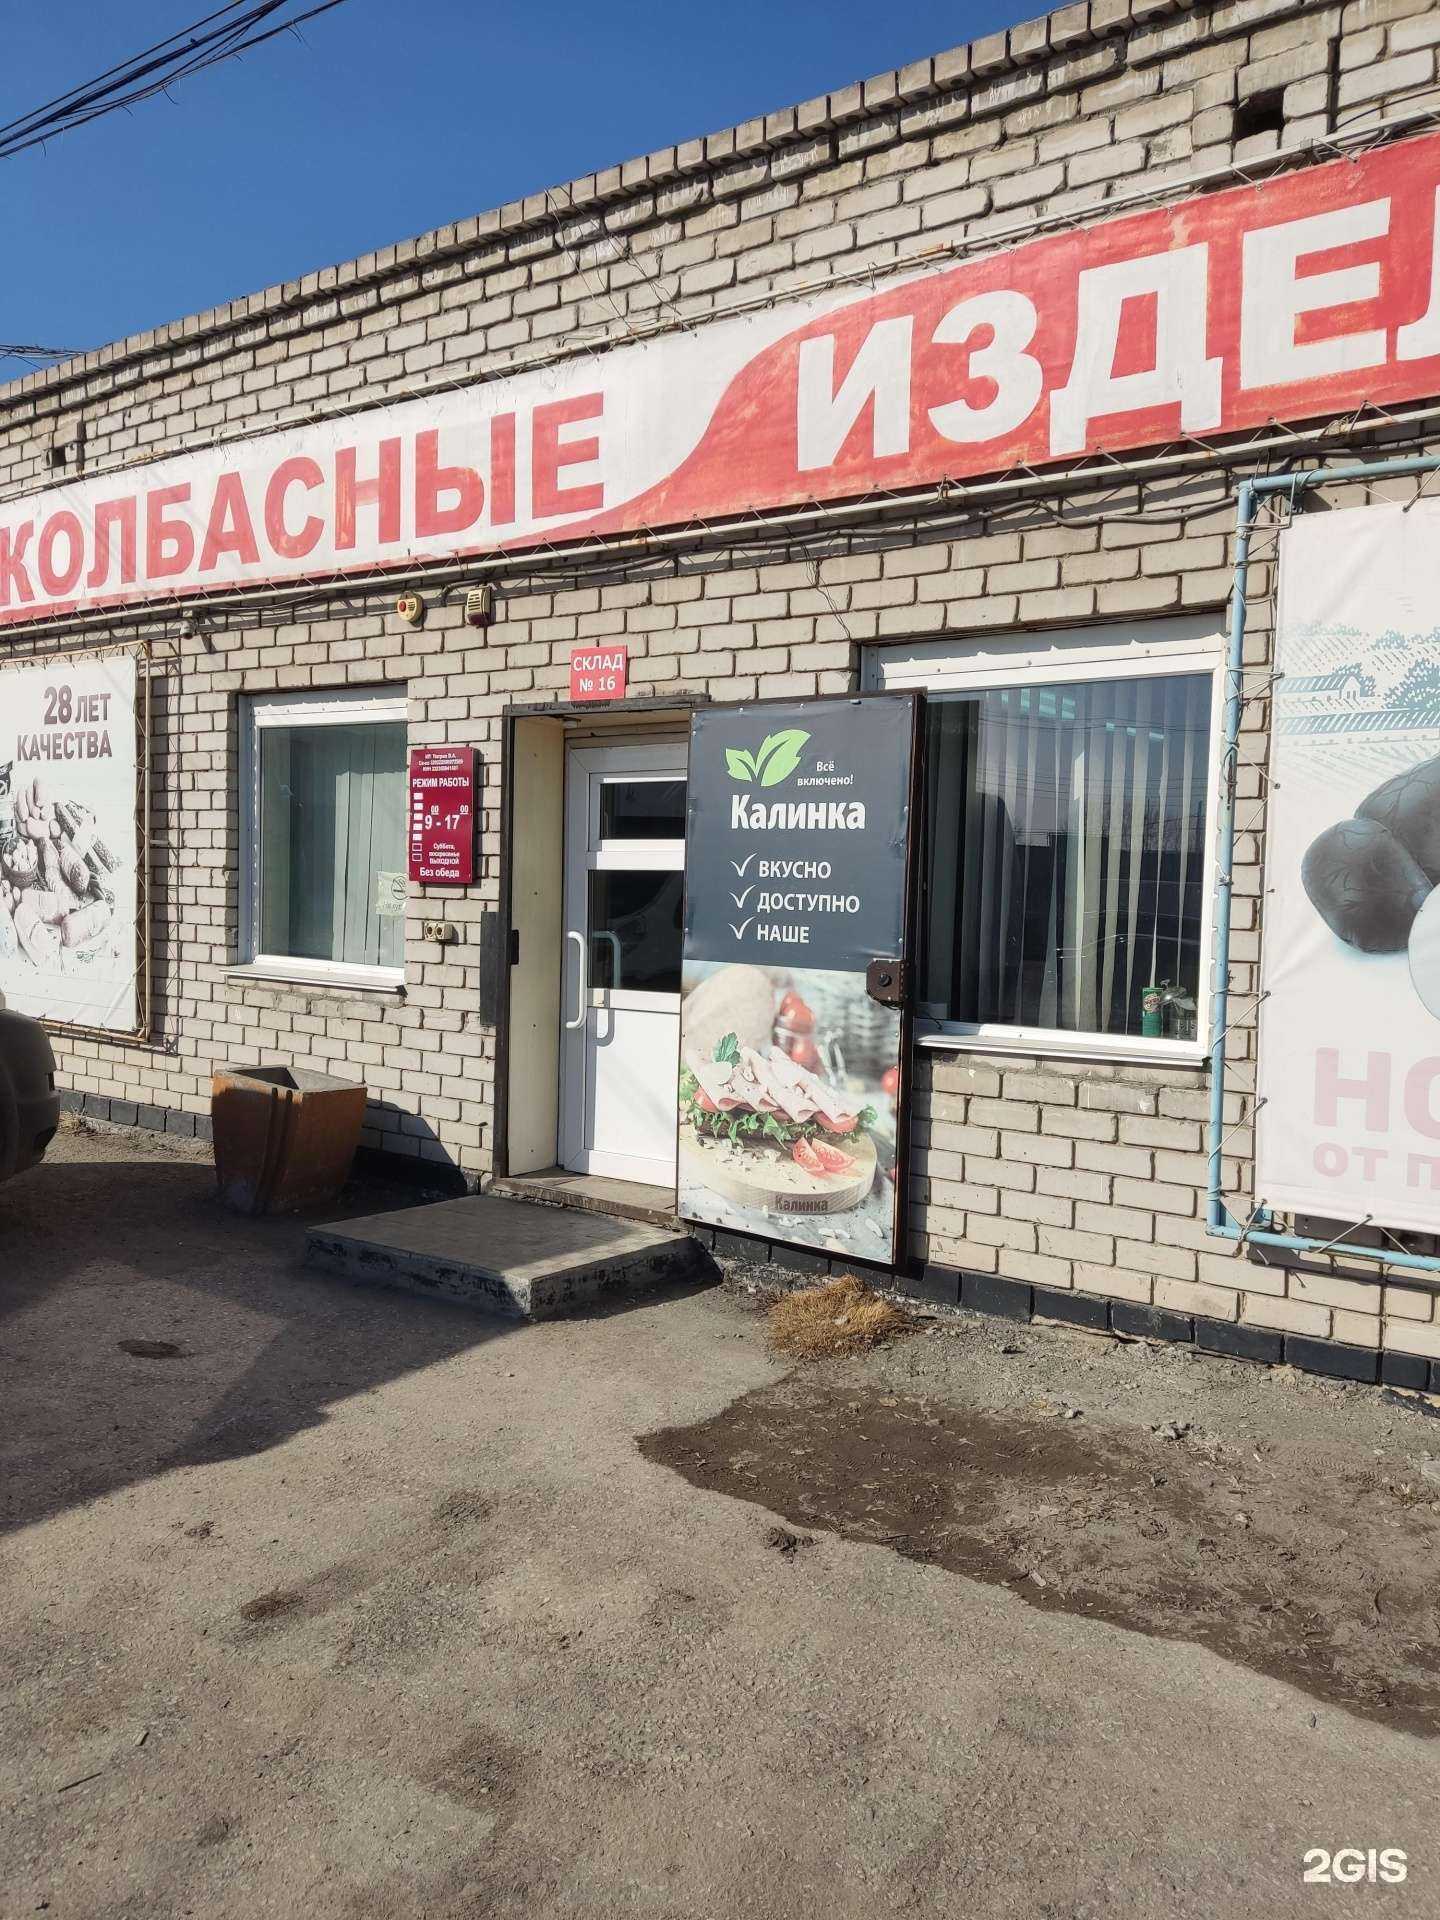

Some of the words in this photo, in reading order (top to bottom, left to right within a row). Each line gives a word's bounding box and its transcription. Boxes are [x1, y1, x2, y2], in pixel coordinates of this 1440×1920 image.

[0, 392, 604, 606] КОЛБАСНЫЕ
[573, 653, 624, 671] СКЛАД
[579, 678, 593, 692] №
[599, 676, 616, 690] 16
[43, 685, 73, 725] 28
[75, 693, 112, 723] ЛЕТ
[17, 730, 113, 761] КАЧЕСТВА
[816, 761, 835, 772] Всё
[412, 778, 438, 788] РЕЖИМ
[439, 777, 469, 787] РАБОТЫ
[797, 774, 854, 786] включено!
[425, 815, 432, 830] 9
[445, 814, 460, 830] 17
[460, 804, 469, 814] 00
[731, 794, 866, 830] Калинка
[420, 867, 434, 877] Без
[435, 868, 459, 878] обеда
[759, 860, 832, 879] ВКУСНО
[757, 892, 860, 913] ДОСТУПНО
[757, 924, 810, 944] НАШЕ
[1312, 1142, 1389, 1182] ОТ
[775, 1194, 828, 1212] Калинка
